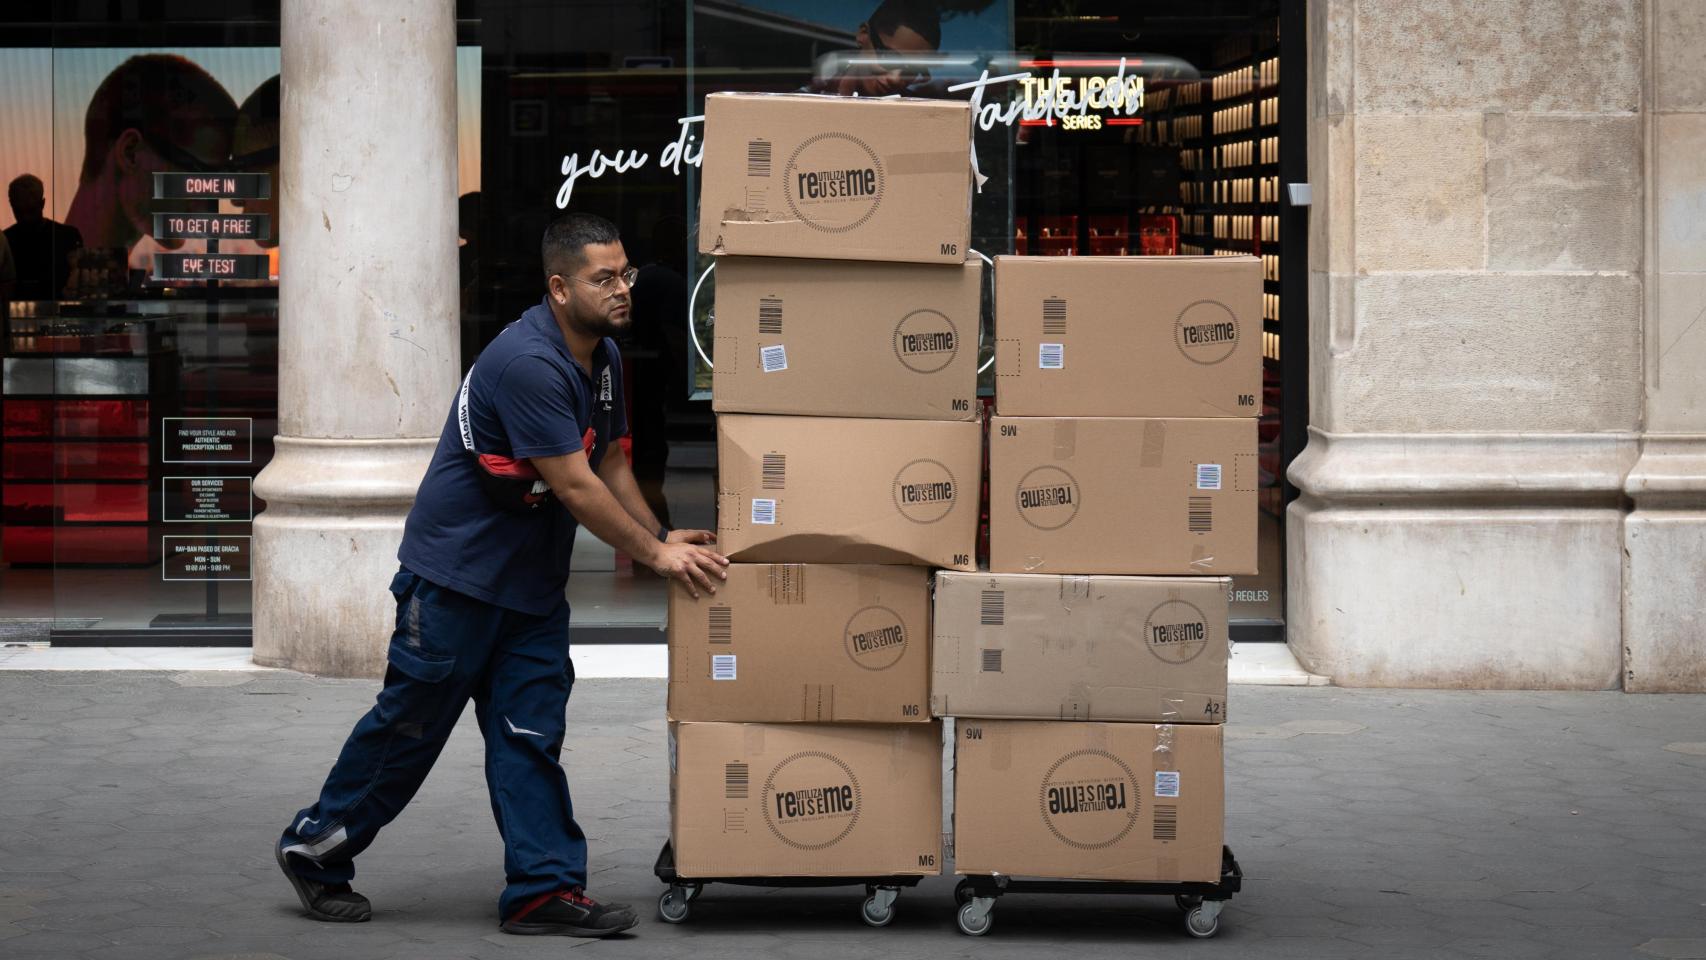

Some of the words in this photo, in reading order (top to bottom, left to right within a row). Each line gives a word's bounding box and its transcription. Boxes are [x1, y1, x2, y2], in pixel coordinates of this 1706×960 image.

[1062, 115, 1102, 130] SERIES
[556, 149, 648, 209] you
[186, 179, 219, 193] COME
[223, 179, 235, 193] IN
[169, 219, 183, 233] TO
[187, 219, 208, 233] GET
[212, 219, 219, 233] A
[223, 219, 251, 234] FREE
[940, 244, 957, 256] M6
[183, 259, 204, 273] EYE
[208, 259, 236, 273] TEST
[952, 399, 969, 411] M6
[1238, 394, 1254, 406] M6
[1000, 425, 1017, 437] M6
[953, 554, 969, 566] M6
[1235, 590, 1269, 602] REGLES
[903, 704, 919, 716] M6
[1204, 703, 1220, 714] A2
[966, 728, 982, 740] M6
[918, 854, 935, 866] M6
